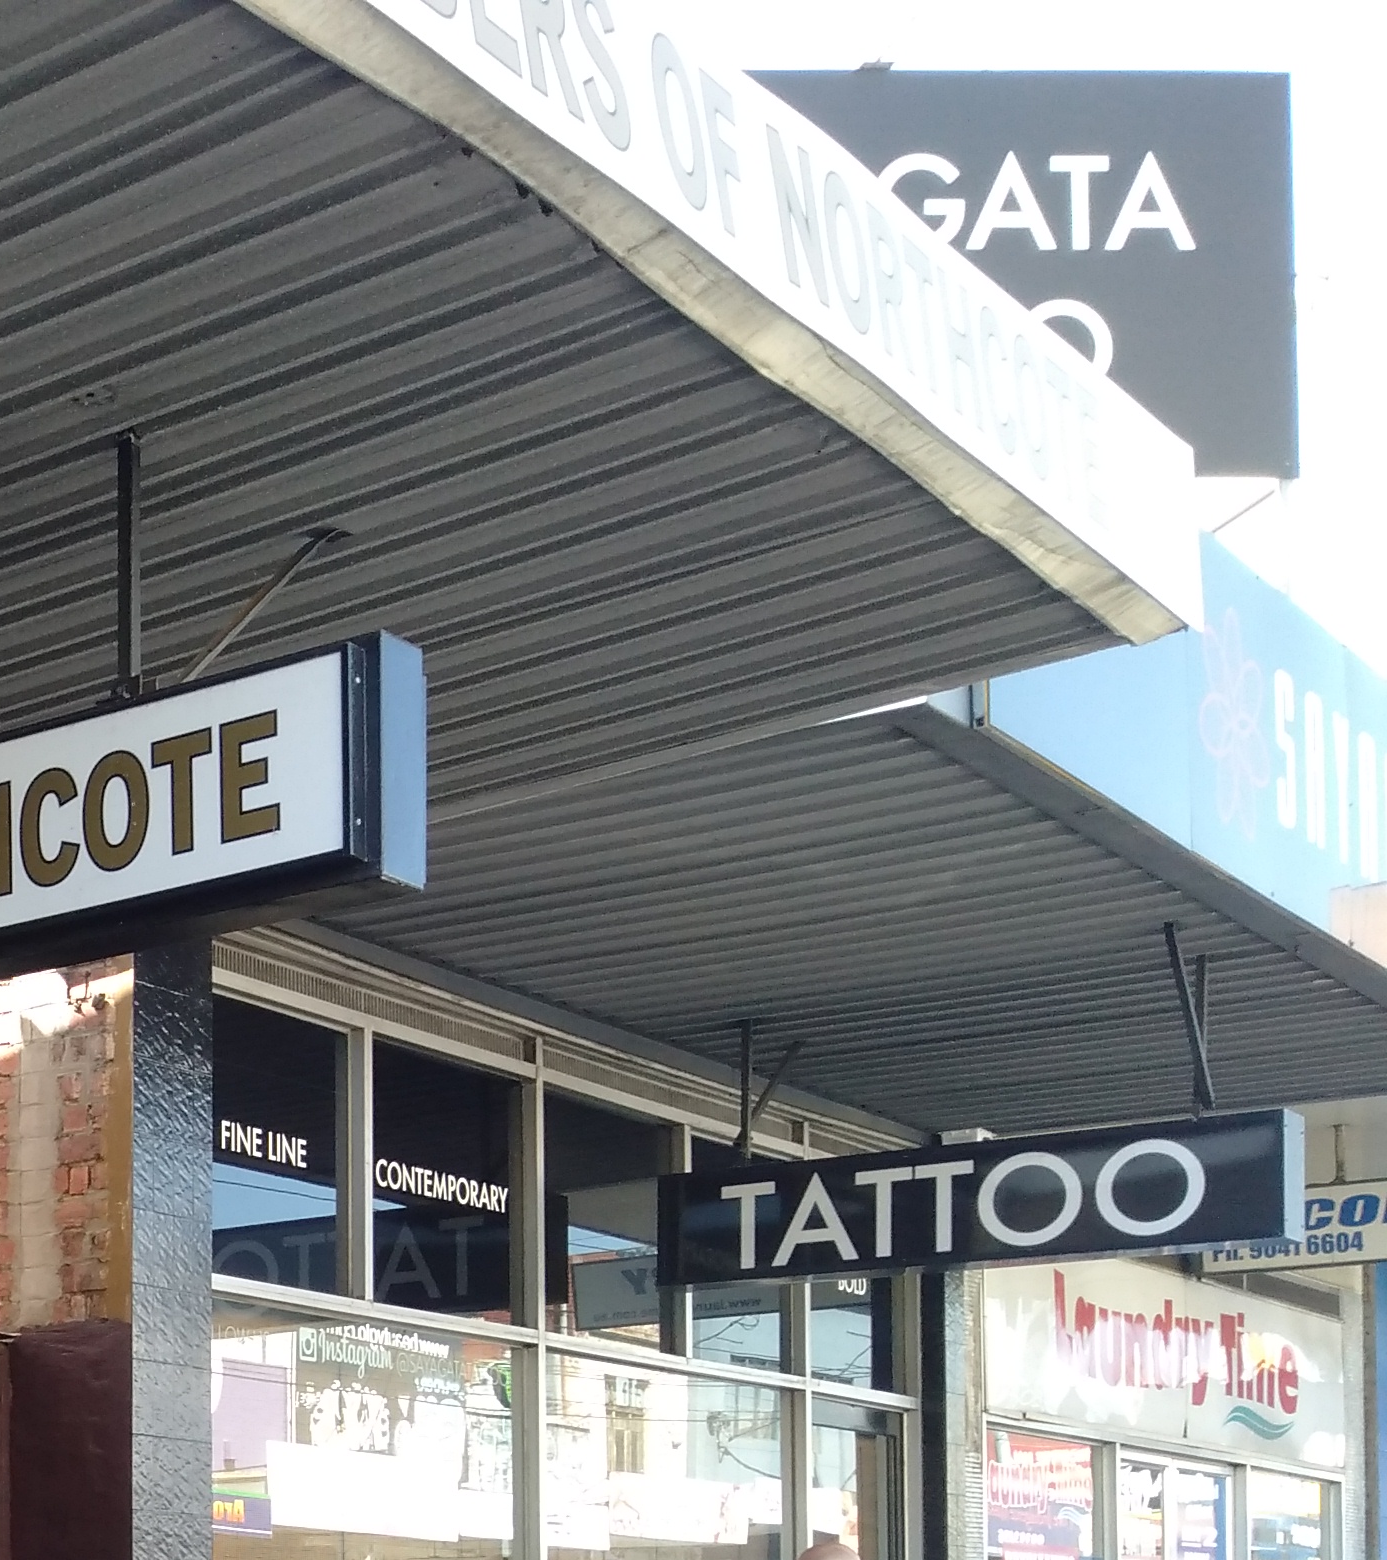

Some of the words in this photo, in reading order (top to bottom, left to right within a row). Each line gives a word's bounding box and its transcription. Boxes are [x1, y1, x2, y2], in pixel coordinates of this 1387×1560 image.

[651, 33, 741, 237] OF
[221, 1120, 262, 1158] FINE
[268, 1131, 307, 1168] LINE
[376, 1159, 508, 1214] CONTEMPORARY
[721, 1138, 1205, 1270] TATTOO
[1307, 1231, 1363, 1255] 6604
